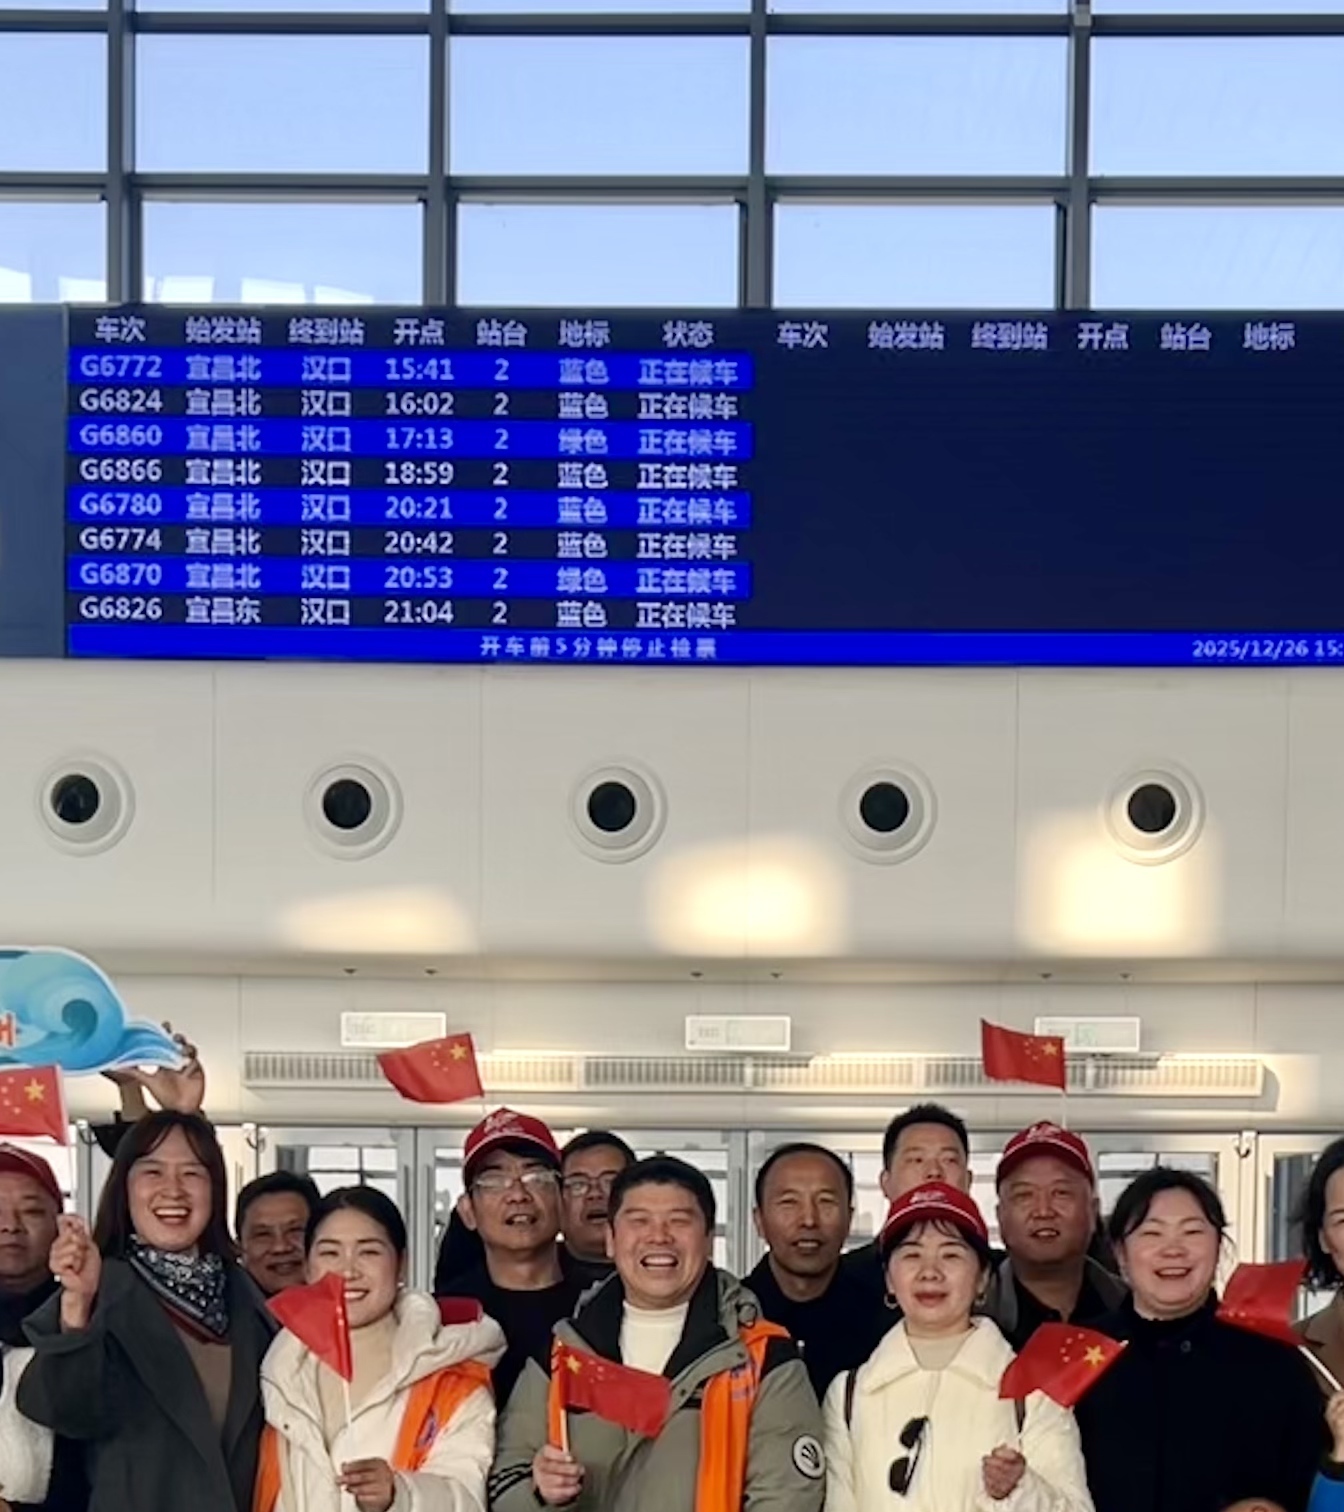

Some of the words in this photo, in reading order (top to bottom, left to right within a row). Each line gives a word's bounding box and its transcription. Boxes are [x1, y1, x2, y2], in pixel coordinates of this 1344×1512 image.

[95, 316, 145, 342] 车次
[186, 316, 261, 343] 始发站
[289, 318, 364, 344] 终到站
[394, 319, 444, 345] 开点
[477, 319, 527, 346] 站台
[559, 320, 610, 347] 地标
[663, 320, 713, 347] 状态
[777, 321, 828, 348] 车次
[868, 321, 944, 349] 始发站
[972, 322, 1047, 350] 终到站
[1078, 323, 1128, 350] 开点
[1161, 323, 1211, 350] 站台
[1243, 322, 1295, 350] 地标
[80, 355, 162, 377] G6772
[186, 355, 261, 381] 宜昌北
[302, 356, 351, 382] 汉口
[386, 358, 454, 380] 15:41
[495, 358, 509, 380] 2
[559, 358, 609, 384] 蓝色
[638, 359, 738, 385] 正在候车
[80, 388, 162, 412] G6824
[186, 388, 261, 416] 宜昌北
[302, 390, 351, 416] 汉口
[387, 392, 453, 415] 16:02
[494, 392, 508, 415] 2
[558, 392, 608, 419] 蓝色
[638, 392, 737, 420] 正在候车
[80, 425, 162, 445] G6860
[186, 424, 261, 451] 宜昌北
[302, 426, 351, 452] 汉口
[387, 428, 453, 449] 17:13
[495, 429, 508, 449] 2
[638, 429, 737, 456] 正在候车
[80, 459, 162, 481] G6866
[186, 459, 261, 486] 宜昌北
[301, 460, 350, 486] 汉口
[386, 462, 453, 484] 18:59
[493, 462, 508, 485] 2
[558, 462, 608, 488] 蓝色
[637, 463, 737, 489] 正在候车
[80, 493, 162, 515] G6780
[186, 492, 261, 521] 宜昌北
[302, 494, 350, 521] 汉口
[386, 496, 452, 518] 20:21
[494, 497, 507, 519] 2
[558, 496, 607, 523] 蓝色
[637, 497, 737, 525] 正在候车
[80, 527, 161, 550] G6774
[186, 528, 261, 555] 宜昌北
[301, 529, 350, 556] 汉口
[385, 531, 453, 553] 20:42
[493, 532, 507, 554] 2
[558, 532, 607, 558] 蓝色
[637, 533, 737, 560] 正在候车
[80, 563, 161, 585] G6870
[186, 563, 261, 589] 宜昌北
[301, 565, 350, 590] 汉口
[385, 566, 452, 588] 20:53
[493, 568, 508, 589] 2
[636, 568, 735, 593] 正在候车
[80, 596, 162, 619] G6826
[186, 596, 261, 624] 宜昌东
[301, 598, 350, 625] 汉口
[385, 600, 453, 623] 21:04
[493, 601, 507, 623] 2
[557, 601, 607, 627] 蓝色
[636, 602, 735, 629] 正在候车
[1193, 640, 1309, 659] 2025/12/26
